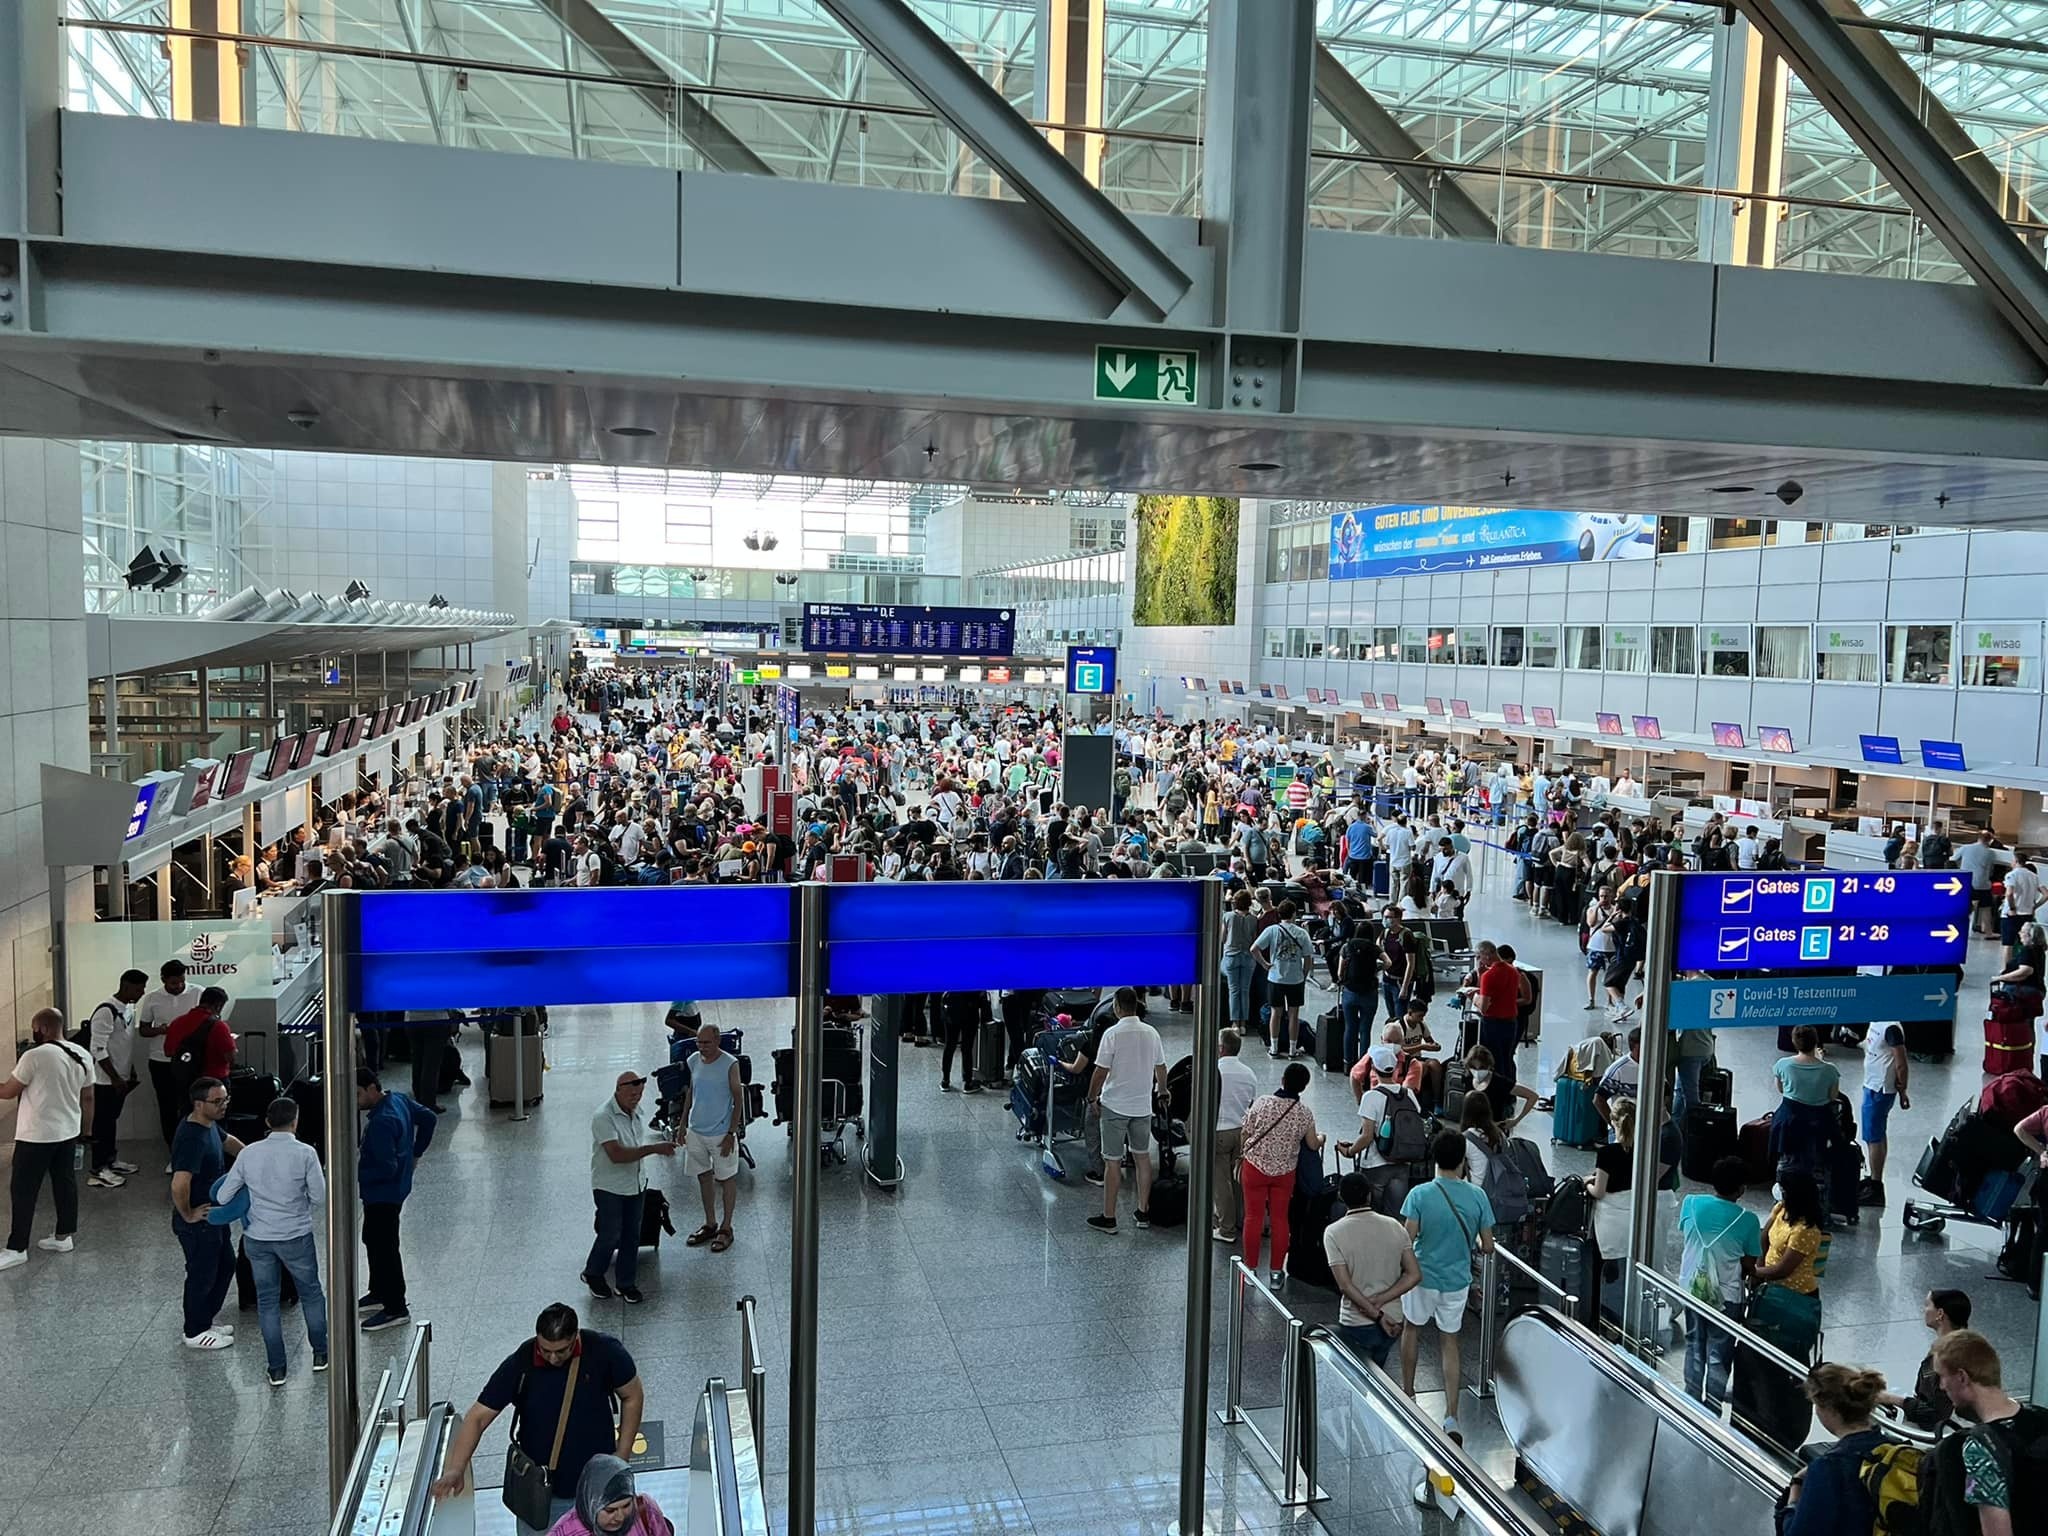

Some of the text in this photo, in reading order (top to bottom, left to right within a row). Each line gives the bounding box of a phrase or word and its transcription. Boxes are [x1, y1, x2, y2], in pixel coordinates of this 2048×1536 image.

[1375, 513, 1399, 530] GUTEN
[1400, 509, 1420, 526] FLUG
[1422, 506, 1439, 524] UND
[1374, 540, 1402, 553] wünschen
[1403, 537, 1413, 550] der
[1462, 531, 1476, 544] und
[1083, 669, 1095, 686] E
[1757, 878, 1800, 894] Gates
[1811, 885, 1827, 905] D
[1841, 877, 1858, 893] 21
[1874, 877, 1895, 893] 49
[1753, 926, 1796, 942] Gates
[1809, 933, 1822, 953] E
[1839, 925, 1855, 941] 21
[1869, 925, 1889, 941] 26
[1743, 986, 1857, 1001] Covid-19 Testzentrum
[1741, 1004, 1838, 1019] Medical screening
